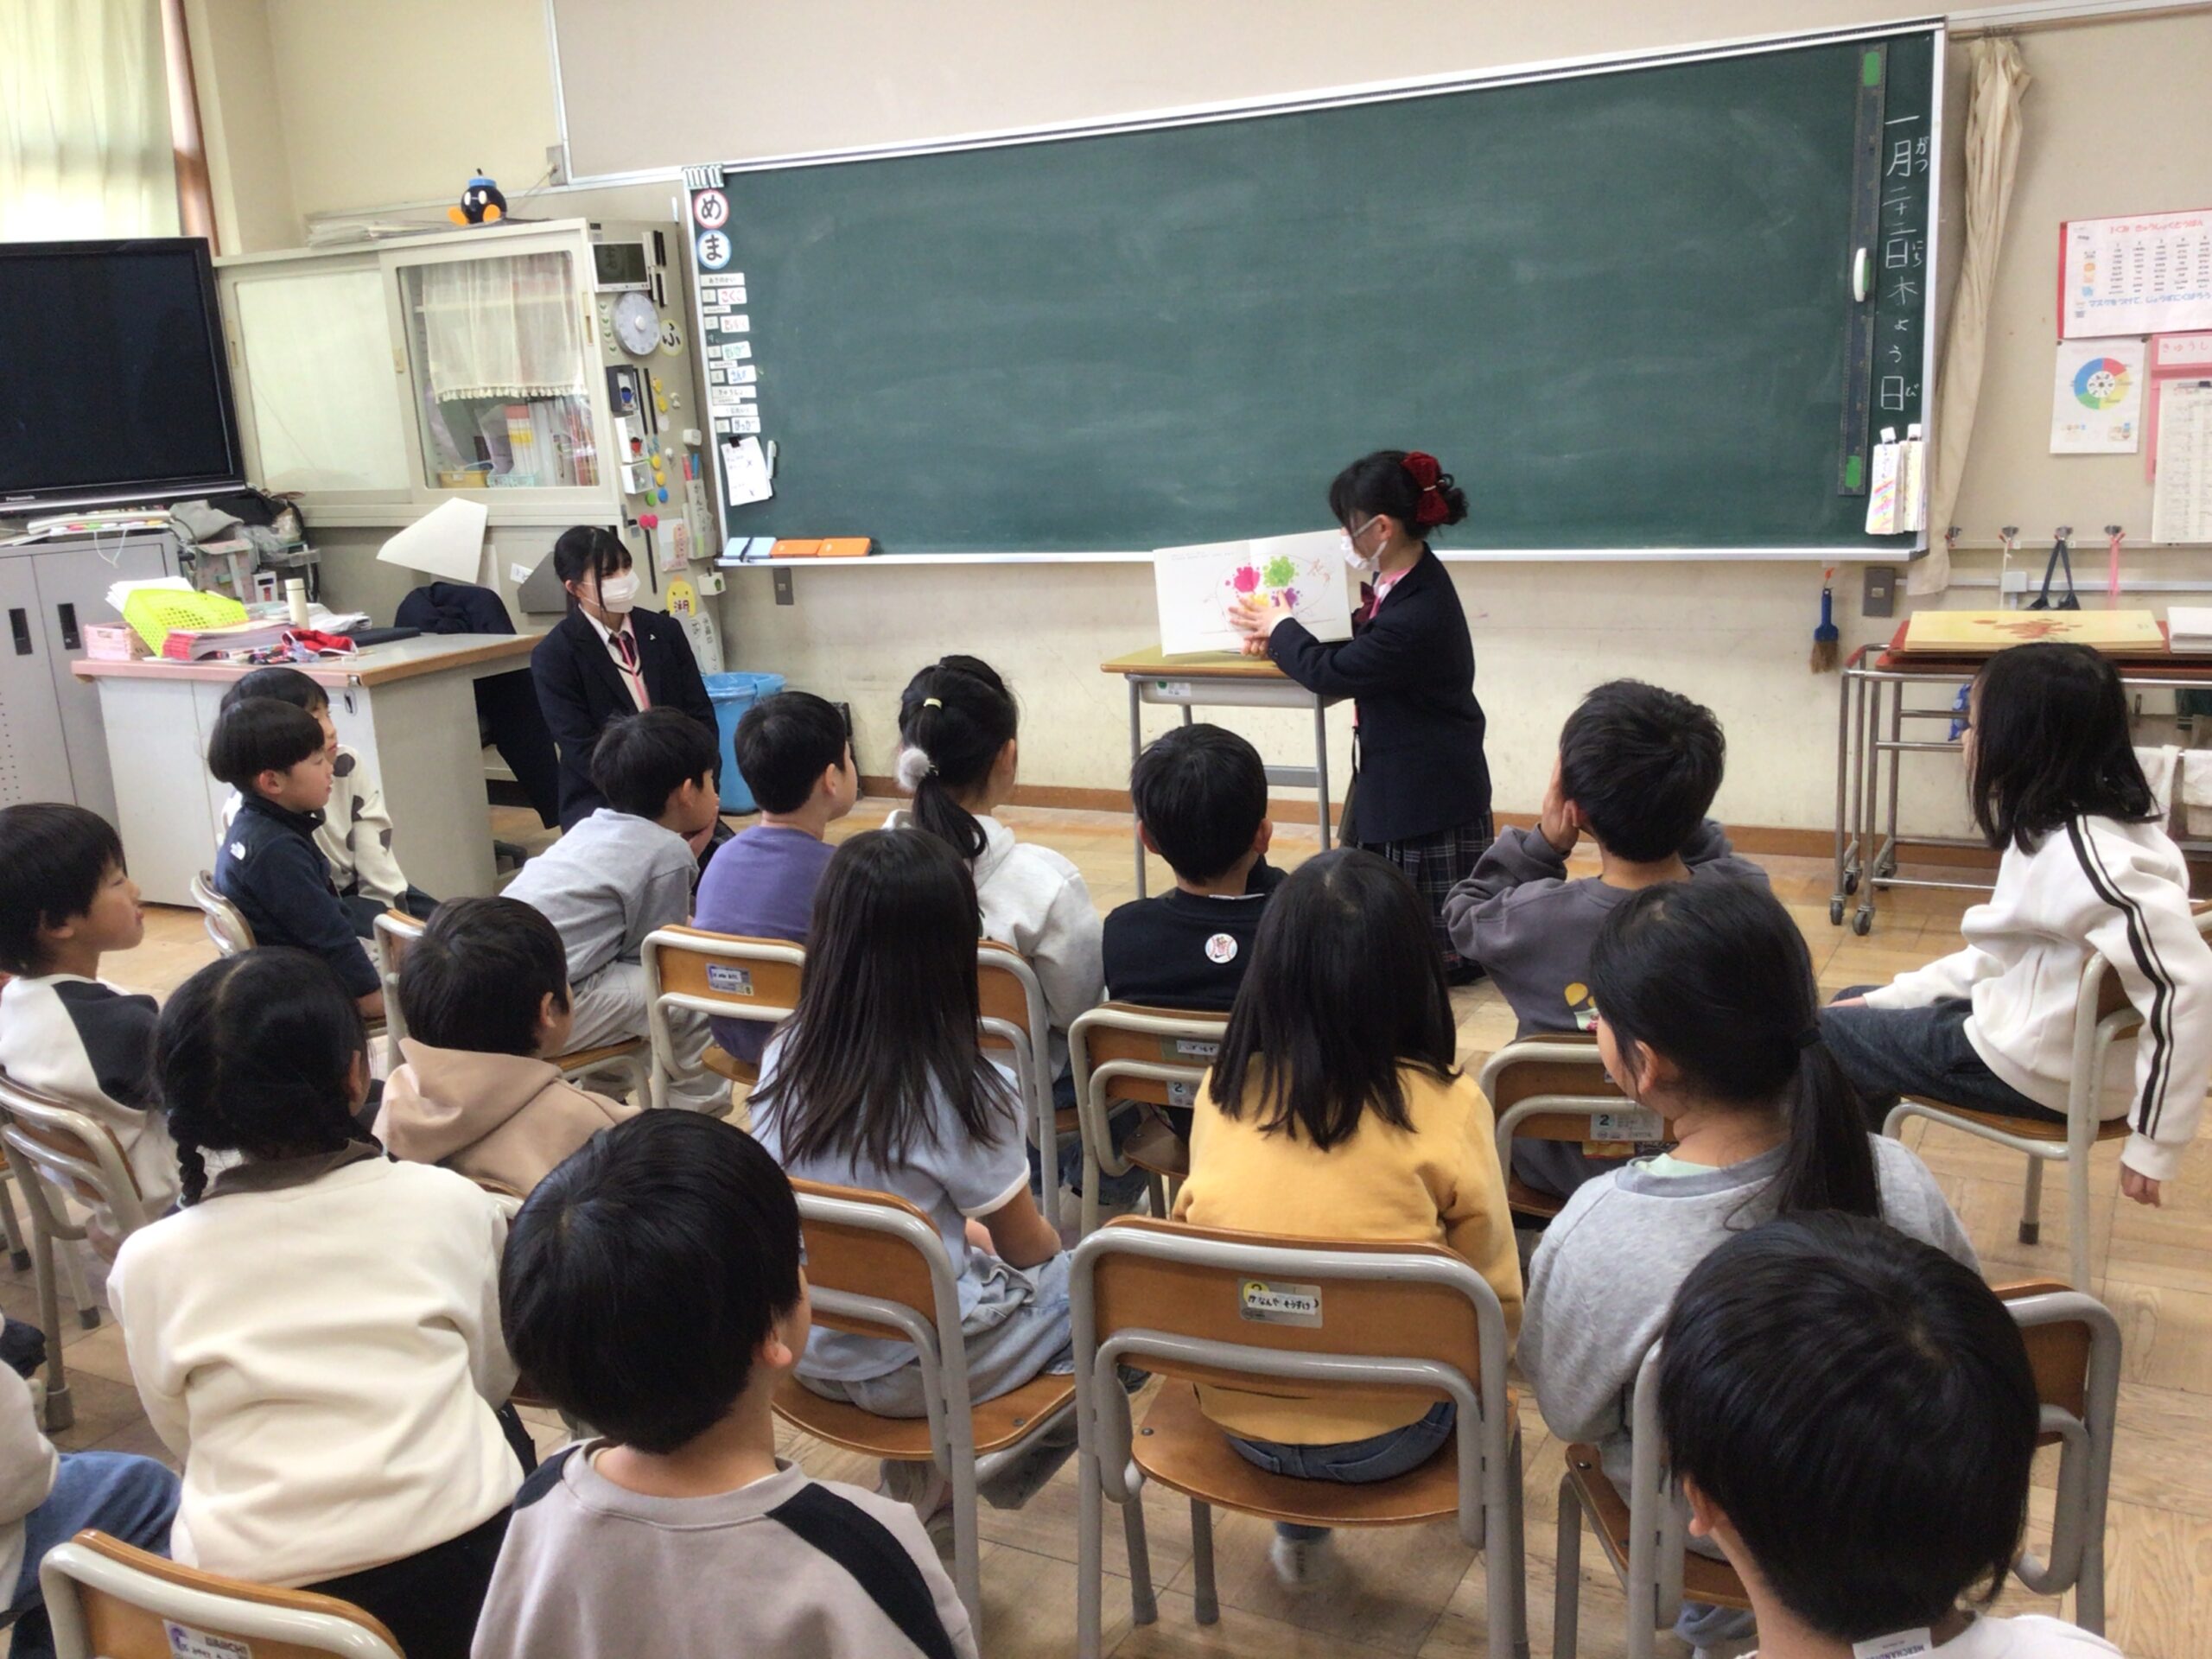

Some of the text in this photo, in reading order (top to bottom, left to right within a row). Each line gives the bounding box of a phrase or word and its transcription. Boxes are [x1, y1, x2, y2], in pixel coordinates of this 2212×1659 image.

[1914, 137, 1929, 173] がつ
[701, 194, 722, 220] め
[704, 233, 723, 261] ま
[662, 322, 681, 347] ふ
[1174, 1082, 1183, 1093] 2
[1599, 1114, 1610, 1126] 2
